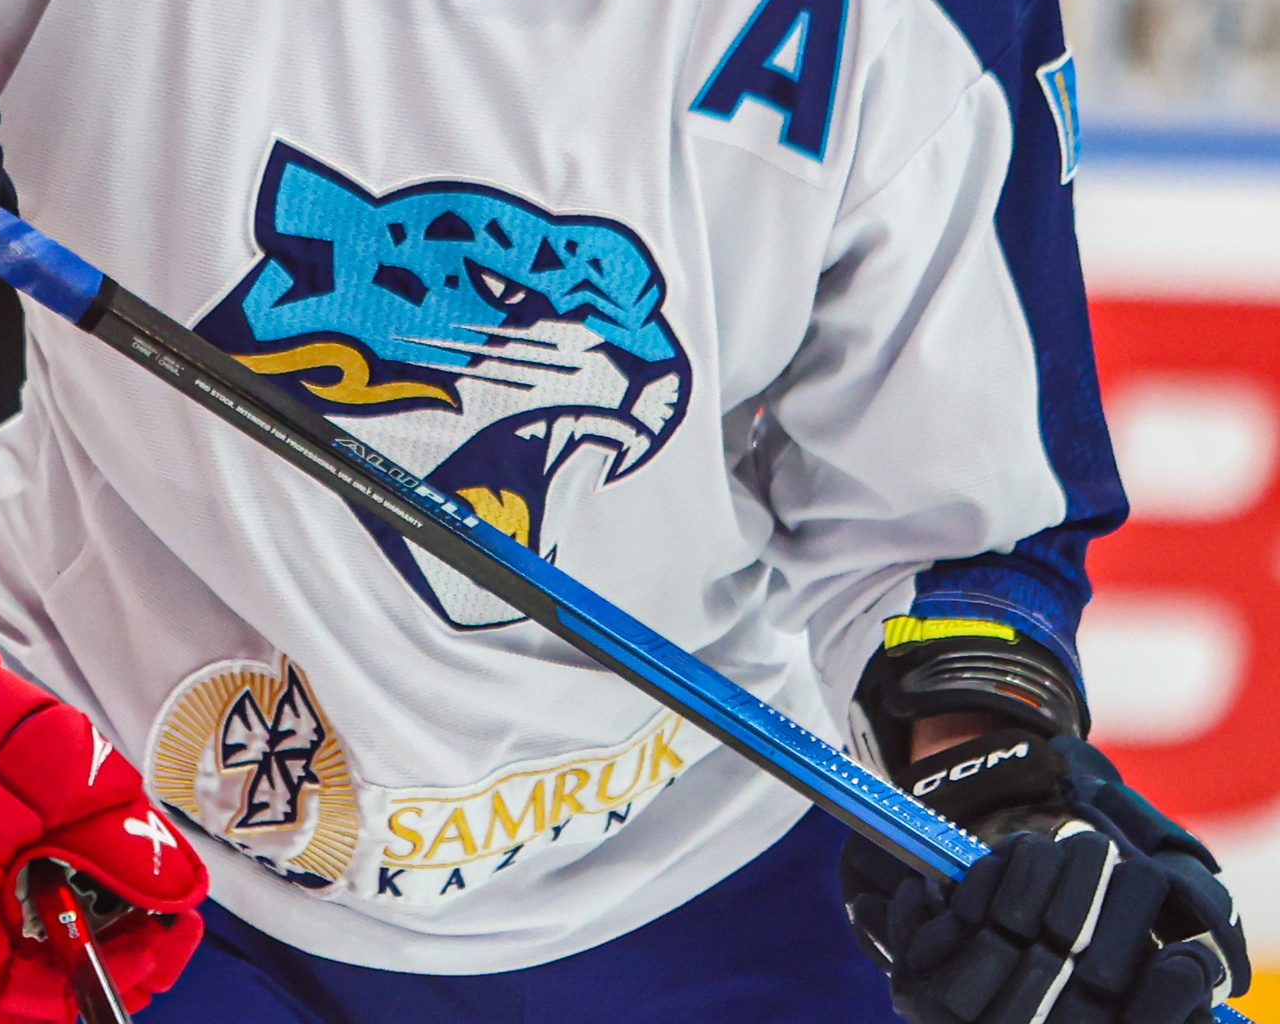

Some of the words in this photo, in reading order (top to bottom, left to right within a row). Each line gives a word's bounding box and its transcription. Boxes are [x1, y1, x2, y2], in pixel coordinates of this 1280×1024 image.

[194, 378, 211, 392] PRO
[236, 405, 271, 431] INTENDED
[271, 428, 286, 441] FOR
[286, 437, 337, 475] PROFESSIONAL
[338, 471, 353, 484] USE
[372, 492, 384, 504] NO
[383, 499, 423, 529] WARRANTY
[380, 729, 686, 860] SAMRUK
[912, 741, 1030, 797] CCM
